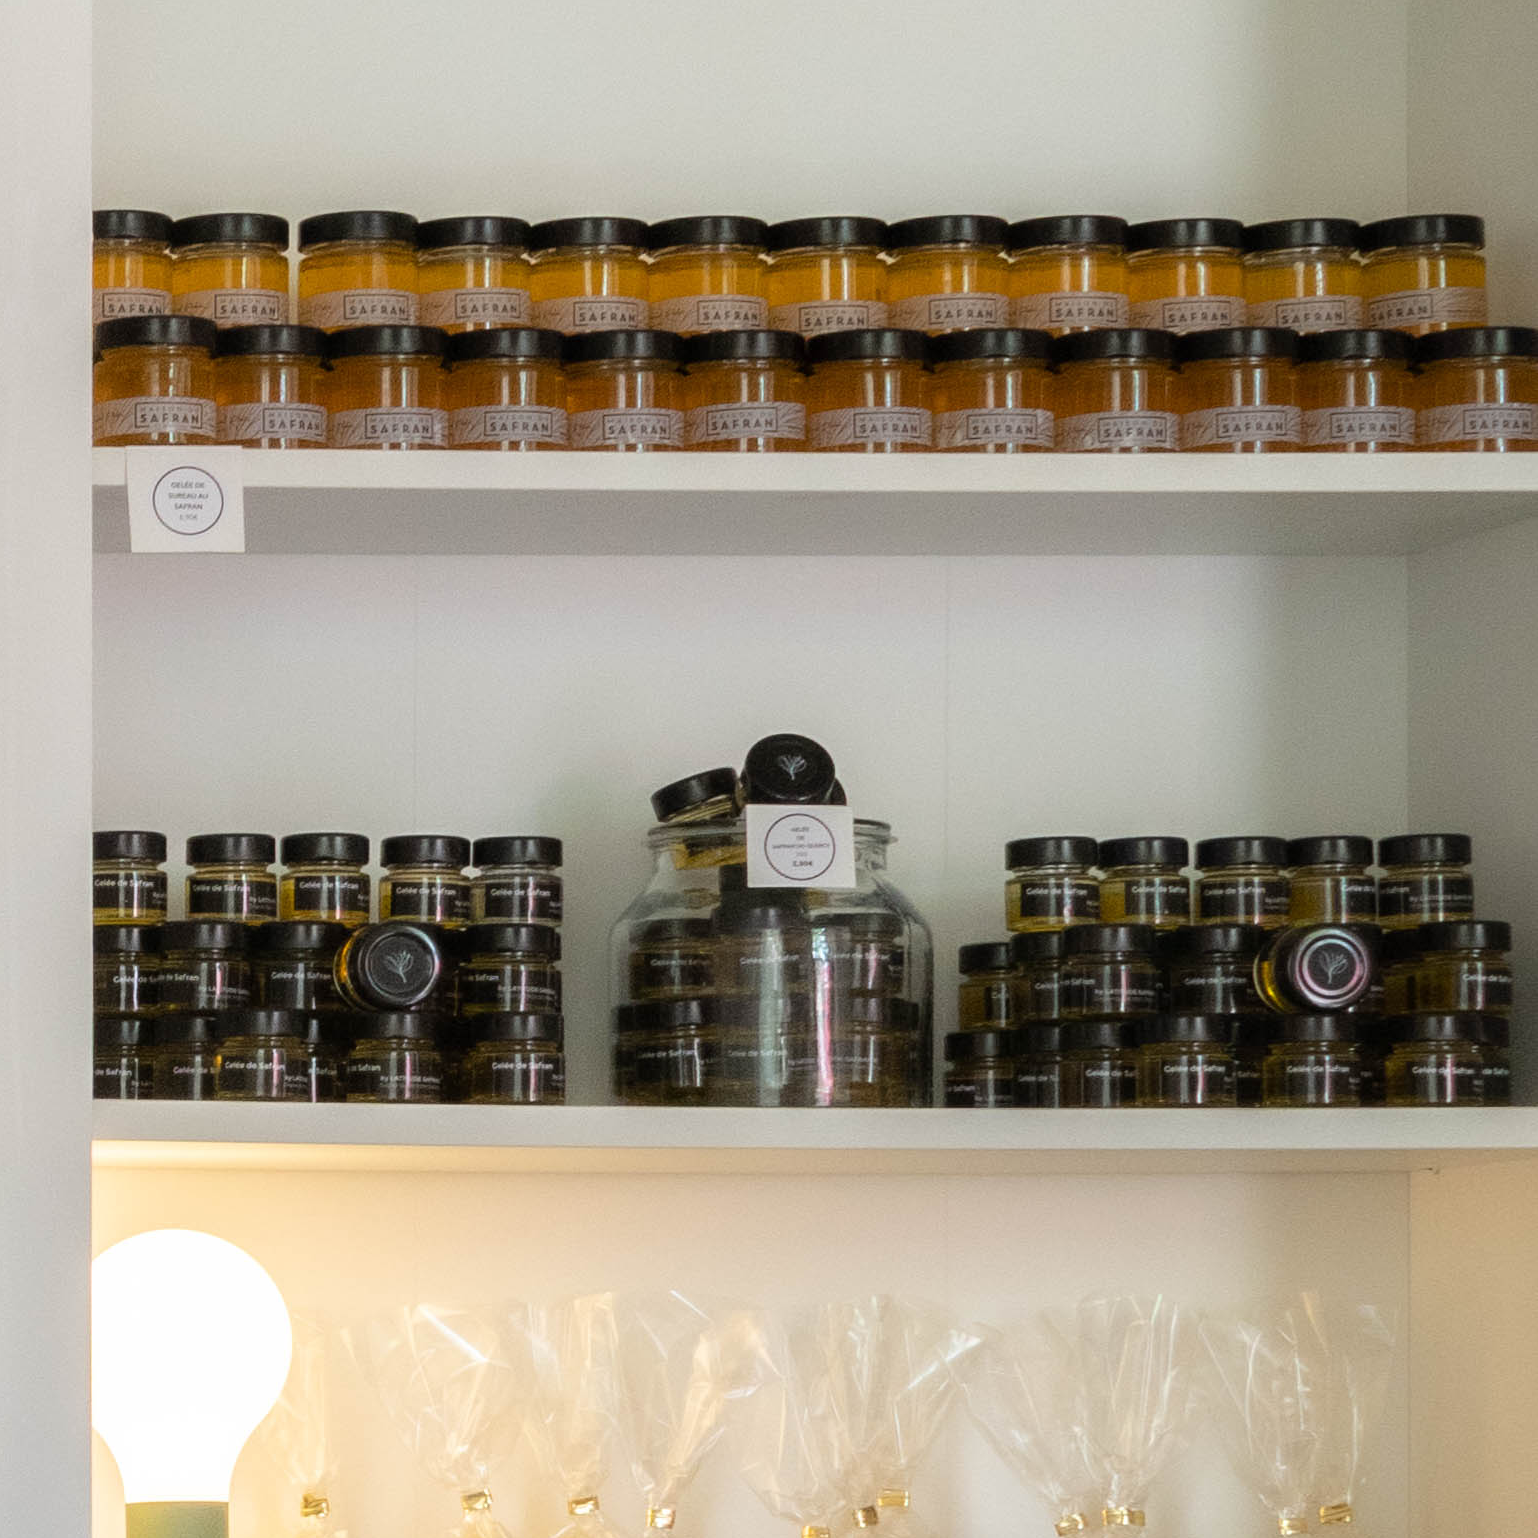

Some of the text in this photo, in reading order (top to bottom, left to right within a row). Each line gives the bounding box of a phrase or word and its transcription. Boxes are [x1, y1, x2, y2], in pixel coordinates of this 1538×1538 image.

[220, 304, 276, 315] SAFRAN
[350, 304, 408, 316] SAFRAN
[460, 303, 519, 314] SAFRAN
[805, 315, 866, 327] SAFRAN
[140, 413, 200, 424] SAFRAN
[370, 423, 430, 435] SAFRAN
[490, 421, 549, 433] SAFRAN
[711, 419, 775, 431] SAFRAN
